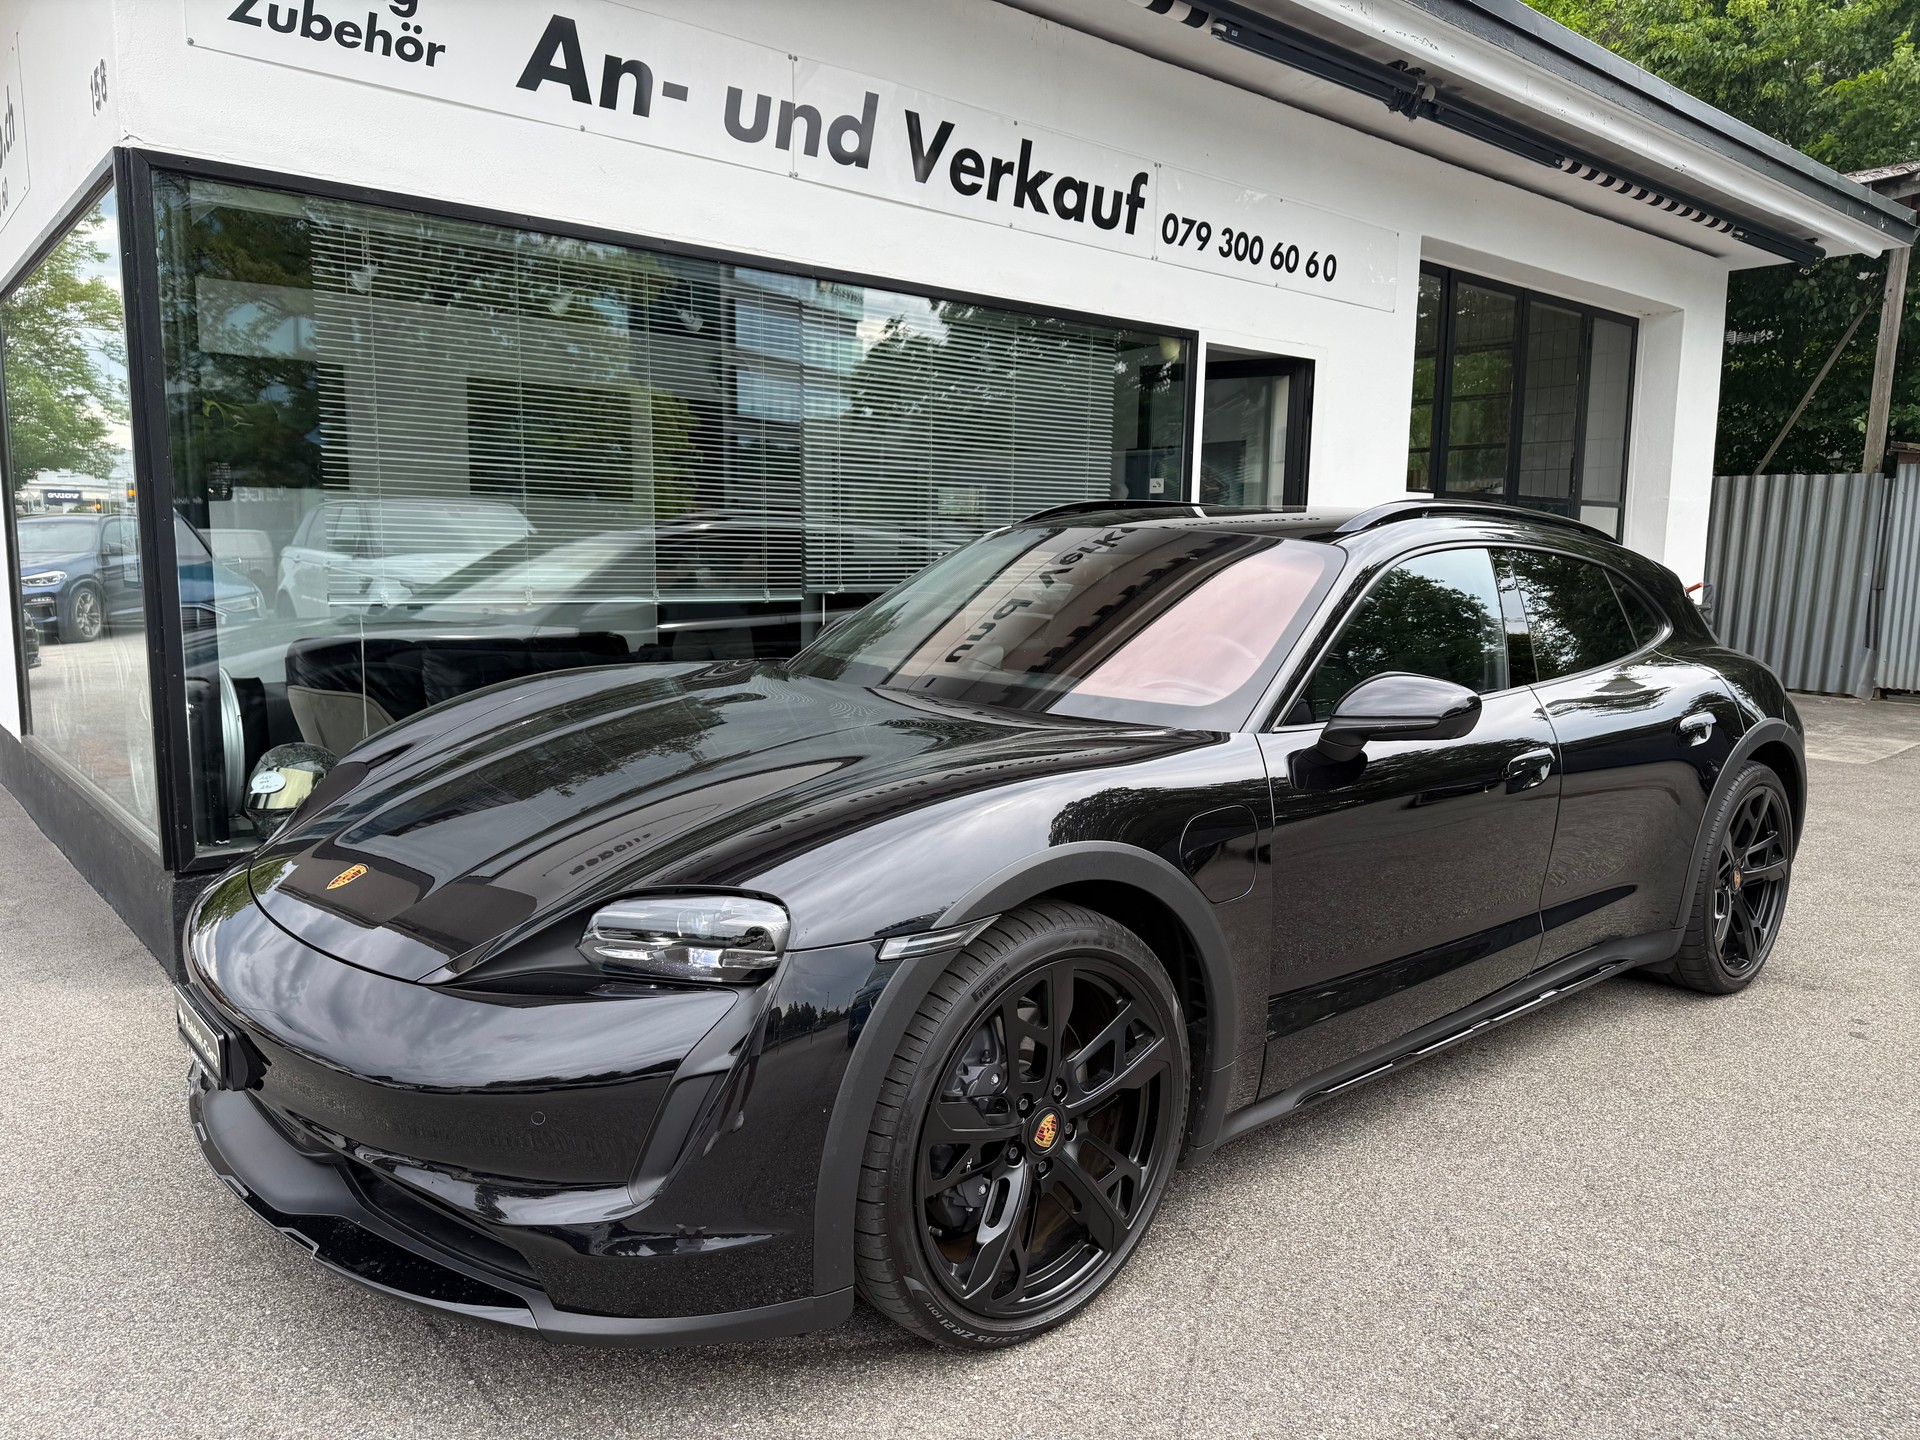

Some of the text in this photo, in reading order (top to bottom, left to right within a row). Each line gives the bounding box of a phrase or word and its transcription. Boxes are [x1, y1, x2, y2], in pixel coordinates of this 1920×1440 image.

[227, 0, 446, 68] Zubehör
[90, 58, 108, 117] 158
[516, 15, 1149, 236] An- und Verkauf
[1162, 213, 1337, 283] 079 300 60 60
